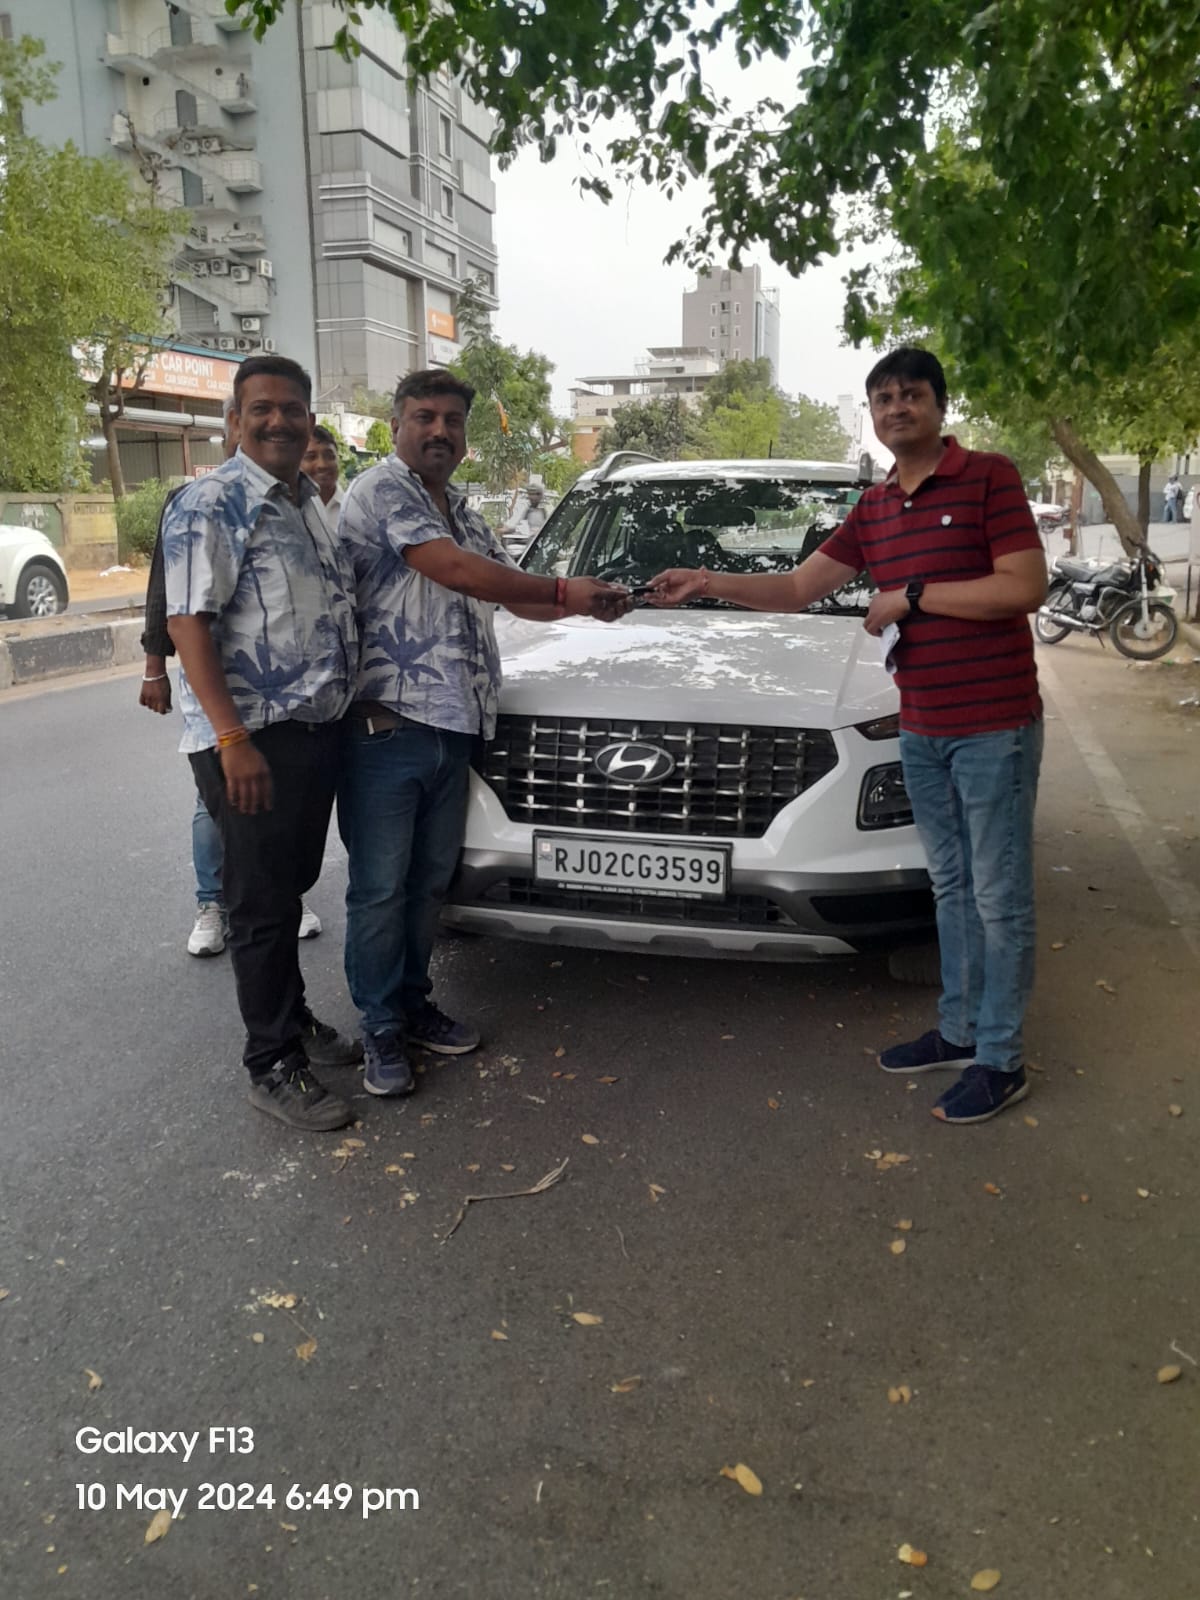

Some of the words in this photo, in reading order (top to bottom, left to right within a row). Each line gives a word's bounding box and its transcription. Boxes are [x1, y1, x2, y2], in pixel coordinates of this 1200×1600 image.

[161, 352, 183, 373] CAR
[184, 357, 214, 377] POINT
[164, 373, 176, 385] CAR
[555, 847, 721, 885] RJ02CG3599
